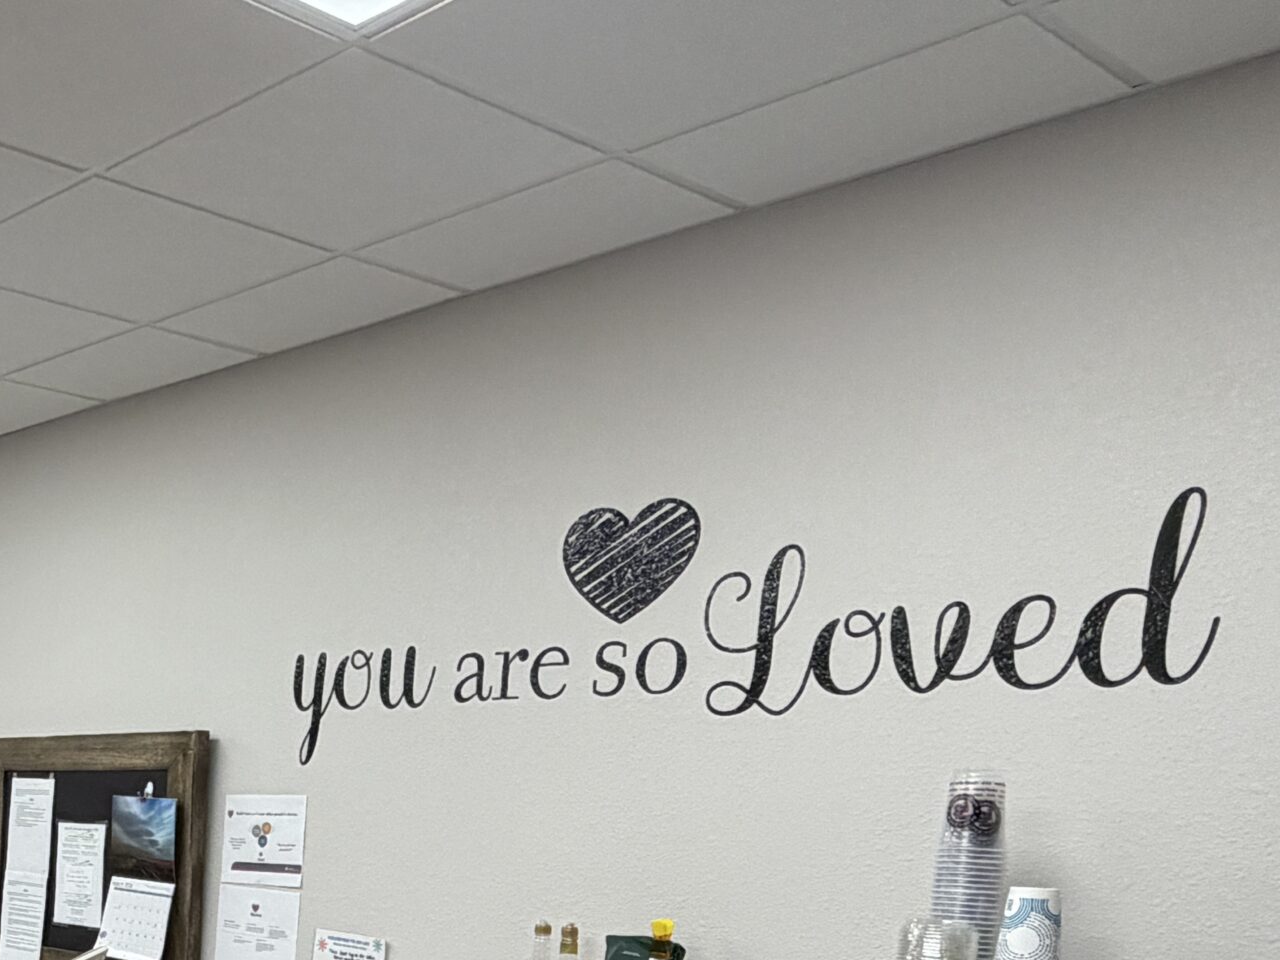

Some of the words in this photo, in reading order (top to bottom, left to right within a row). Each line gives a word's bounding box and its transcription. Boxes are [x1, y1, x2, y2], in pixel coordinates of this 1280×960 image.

[293, 644, 436, 766] you
[453, 645, 570, 704] are
[592, 637, 688, 697] so
[704, 486, 1221, 716] Loved
